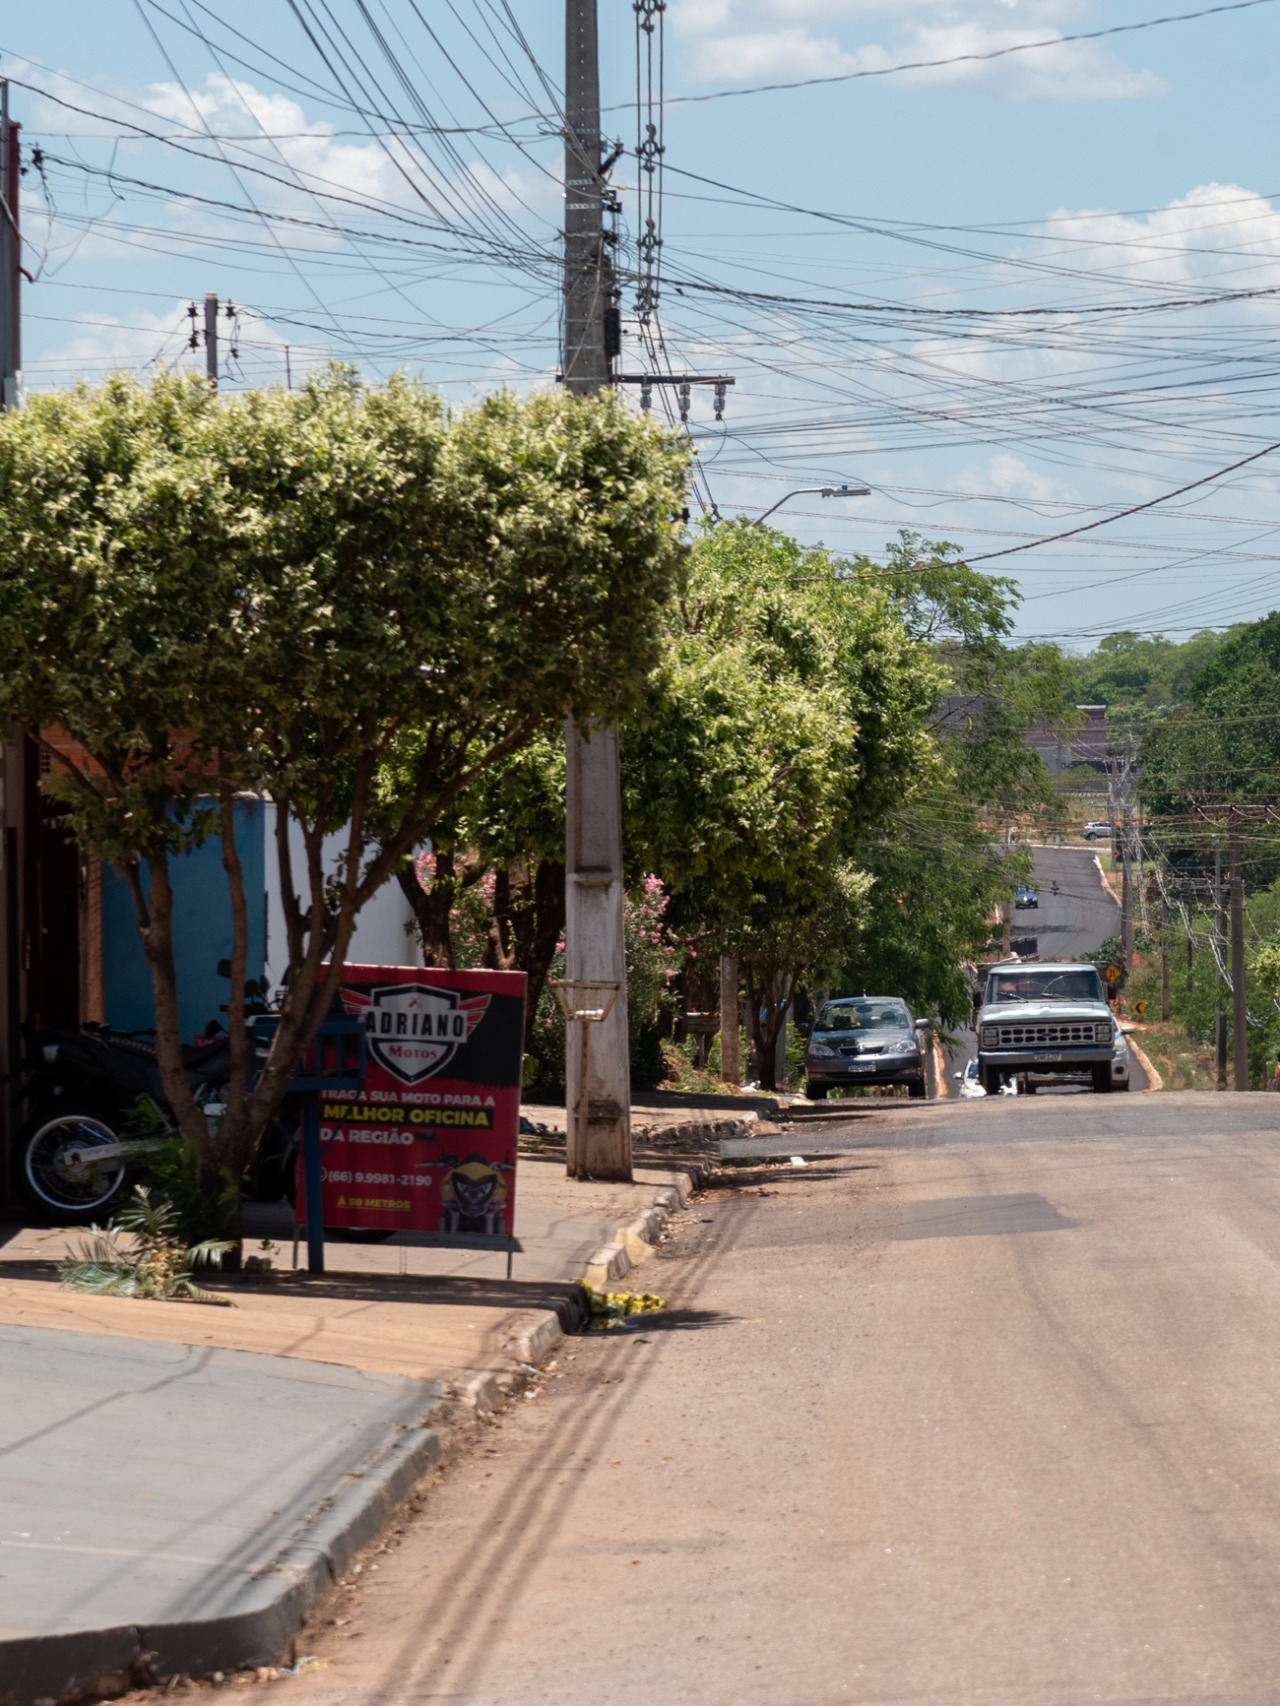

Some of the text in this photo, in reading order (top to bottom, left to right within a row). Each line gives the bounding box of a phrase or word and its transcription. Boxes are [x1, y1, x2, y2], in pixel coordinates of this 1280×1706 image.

[366, 1011, 464, 1037] ADRIANO
[370, 1090, 398, 1102] SUA
[401, 1091, 441, 1104] MOTO
[444, 1093, 482, 1106] PARA
[485, 1095, 496, 1107] A
[409, 1108, 489, 1126] OFICINA
[319, 1128, 414, 1145] DA REGIÃO
[328, 1170, 353, 1183] (66)
[365, 1198, 412, 1208] METROS
